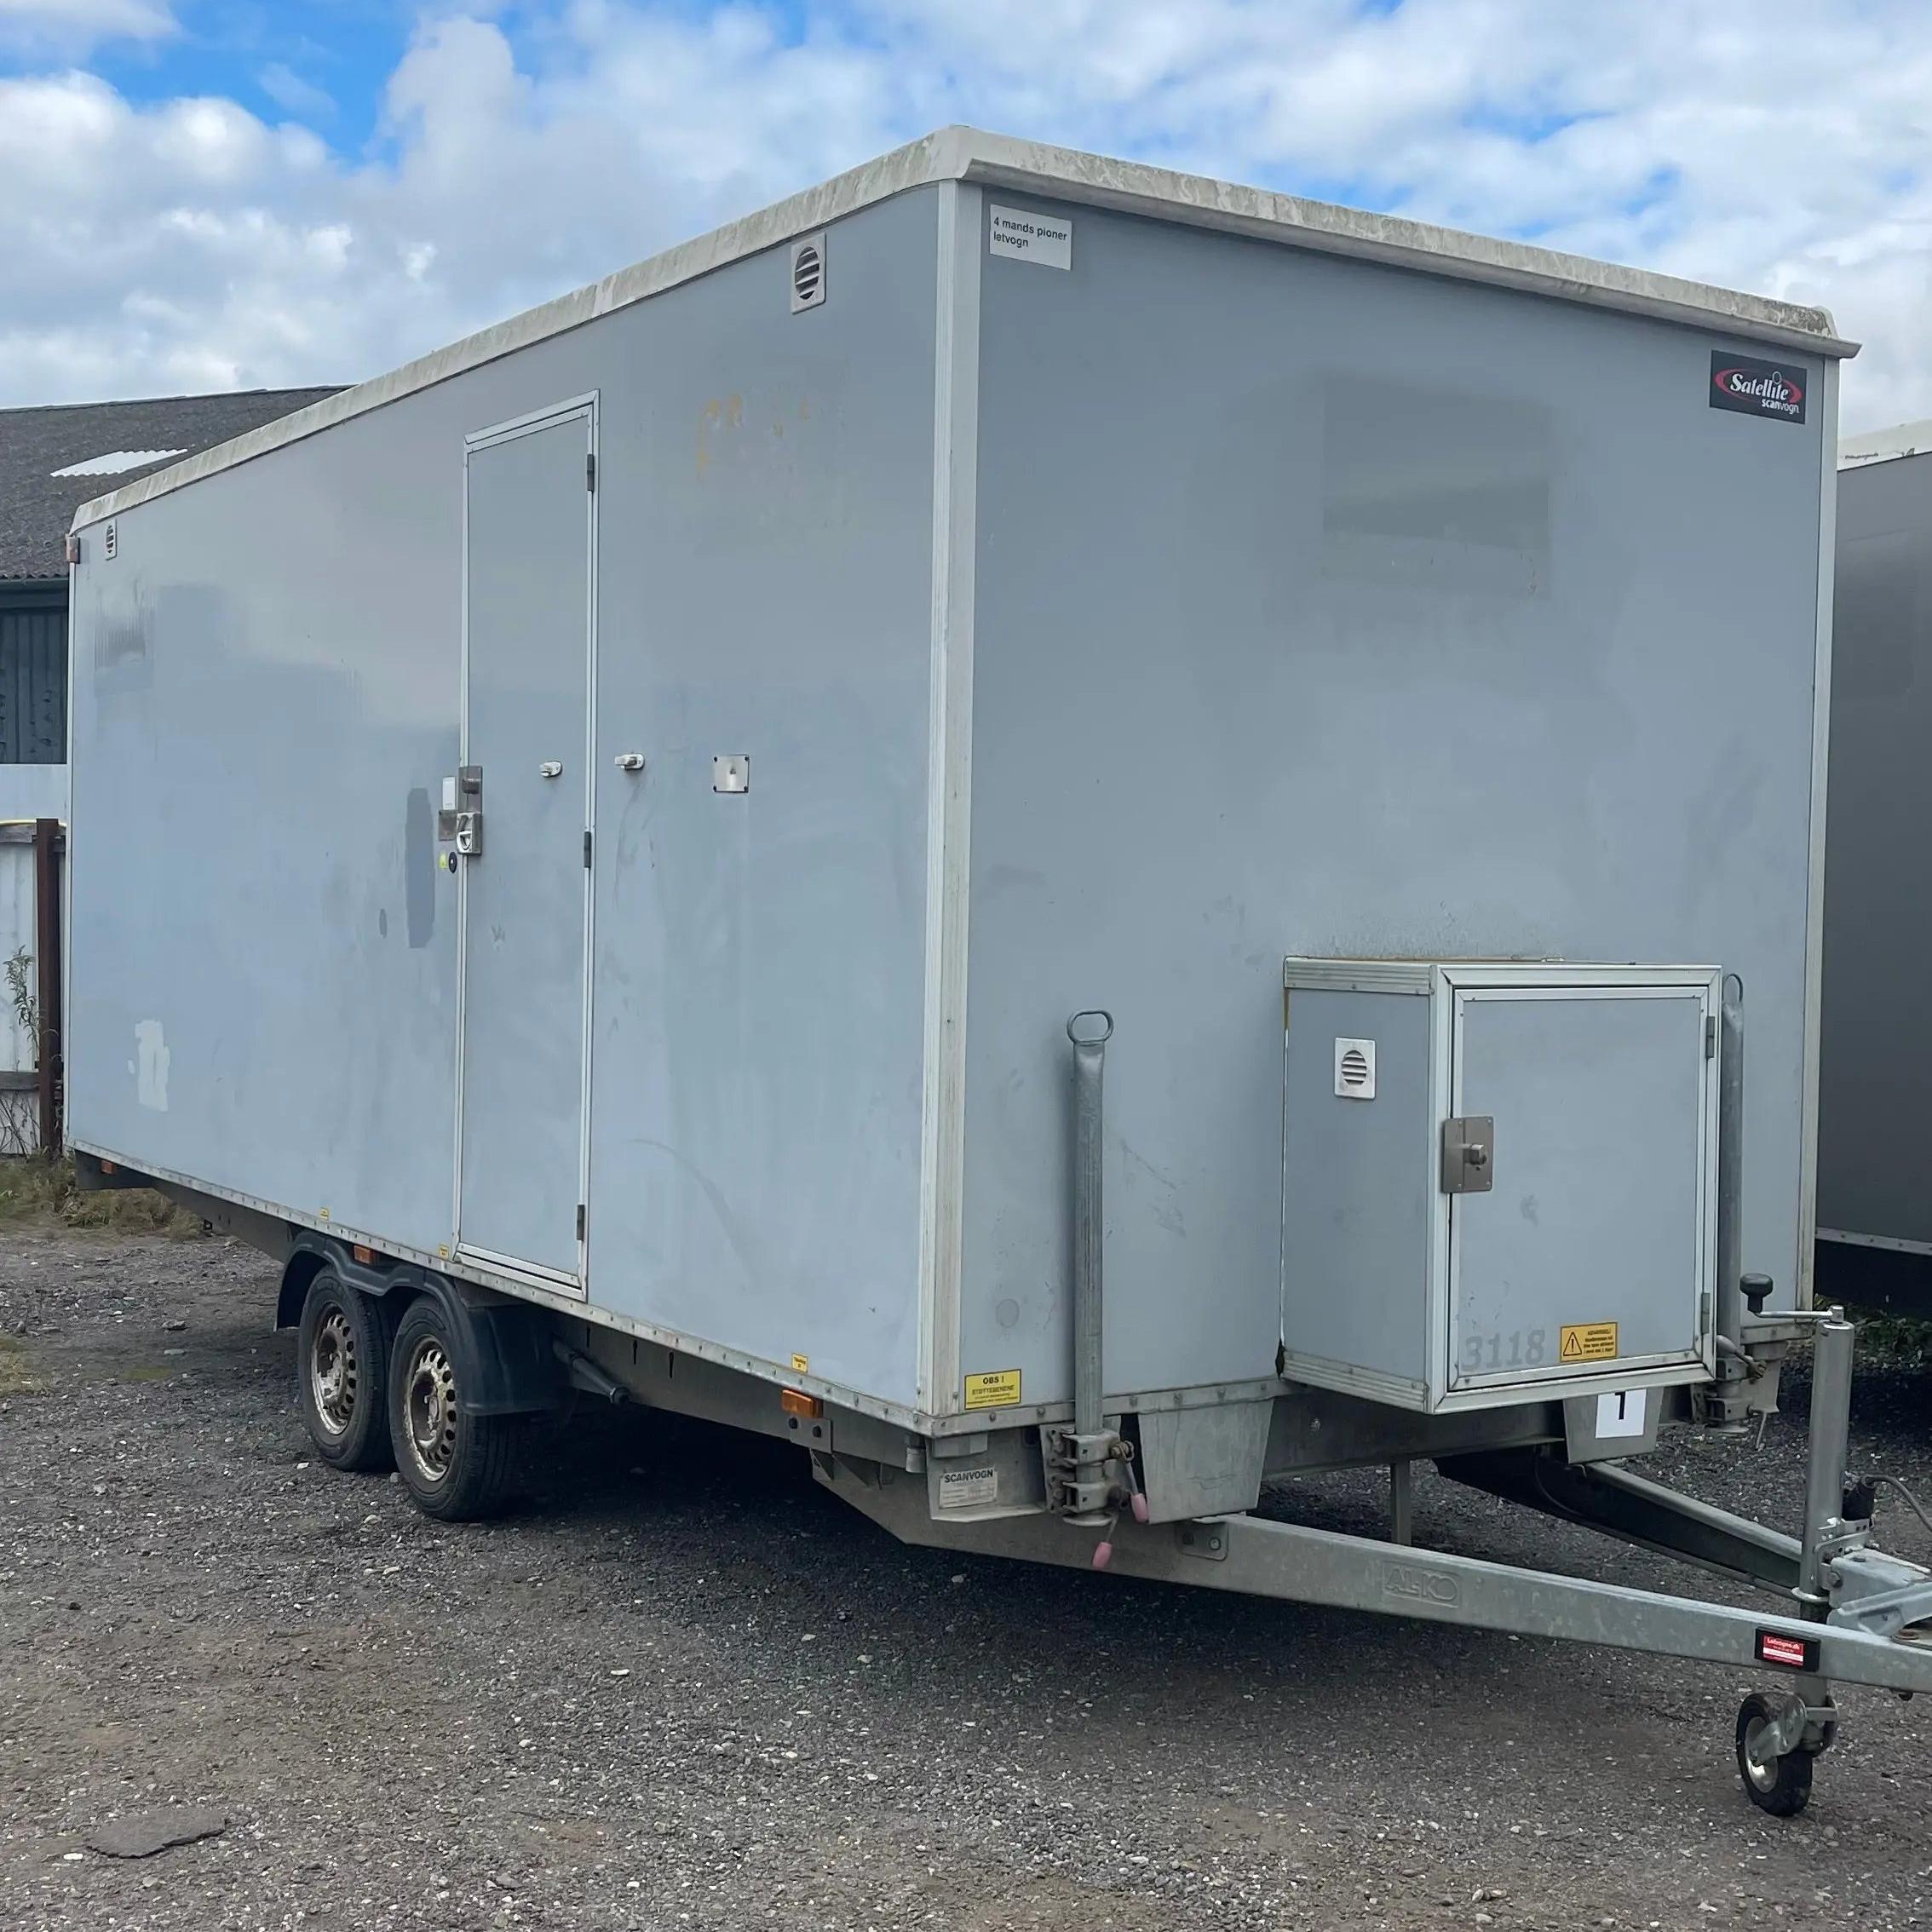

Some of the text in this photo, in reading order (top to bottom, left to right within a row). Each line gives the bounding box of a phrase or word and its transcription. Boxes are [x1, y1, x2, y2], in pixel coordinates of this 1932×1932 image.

[993, 216, 1067, 241] 4 mands pioner
[993, 231, 1029, 249] letvogn
[1730, 373, 1789, 401] Satellite
[1761, 398, 1800, 415] scanvogn
[1461, 1329, 1546, 1372] 3118
[982, 1376, 1000, 1385] OBS
[944, 1469, 994, 1483] SCANVOGN
